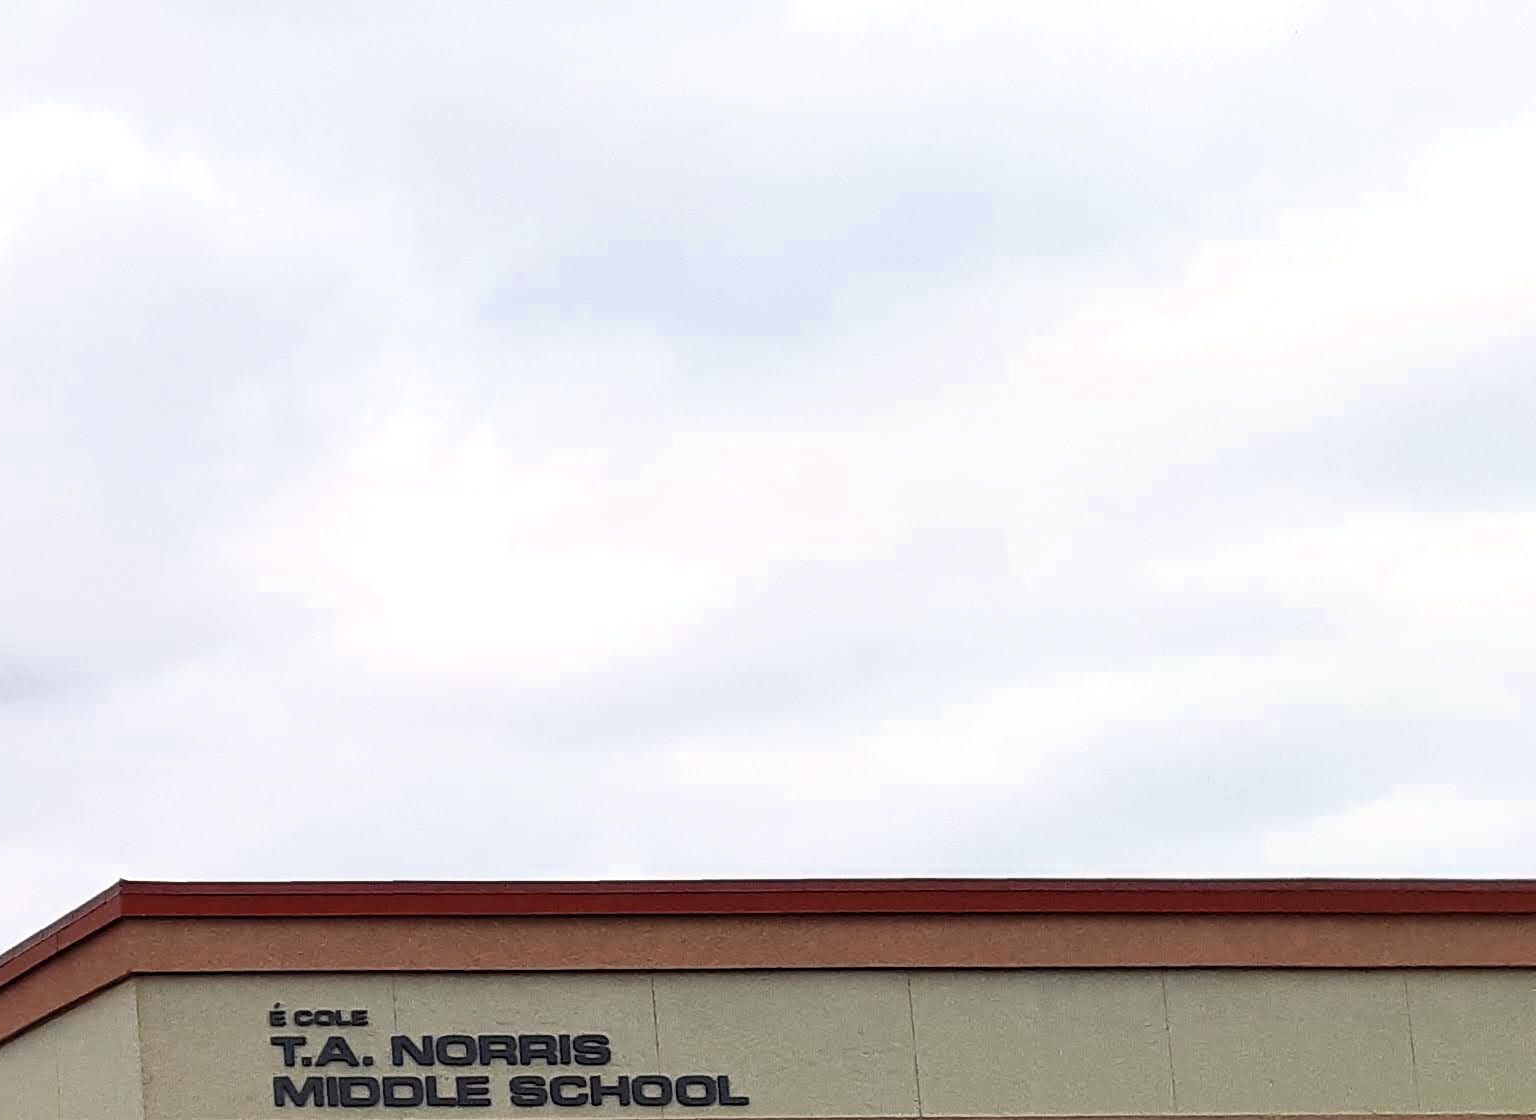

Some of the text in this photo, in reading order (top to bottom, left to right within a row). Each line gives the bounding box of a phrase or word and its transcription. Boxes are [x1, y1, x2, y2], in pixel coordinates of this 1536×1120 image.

[270, 1033, 612, 1067] T.A. NORRIS
[272, 1074, 751, 1108] MIDDLE SCHOOL
